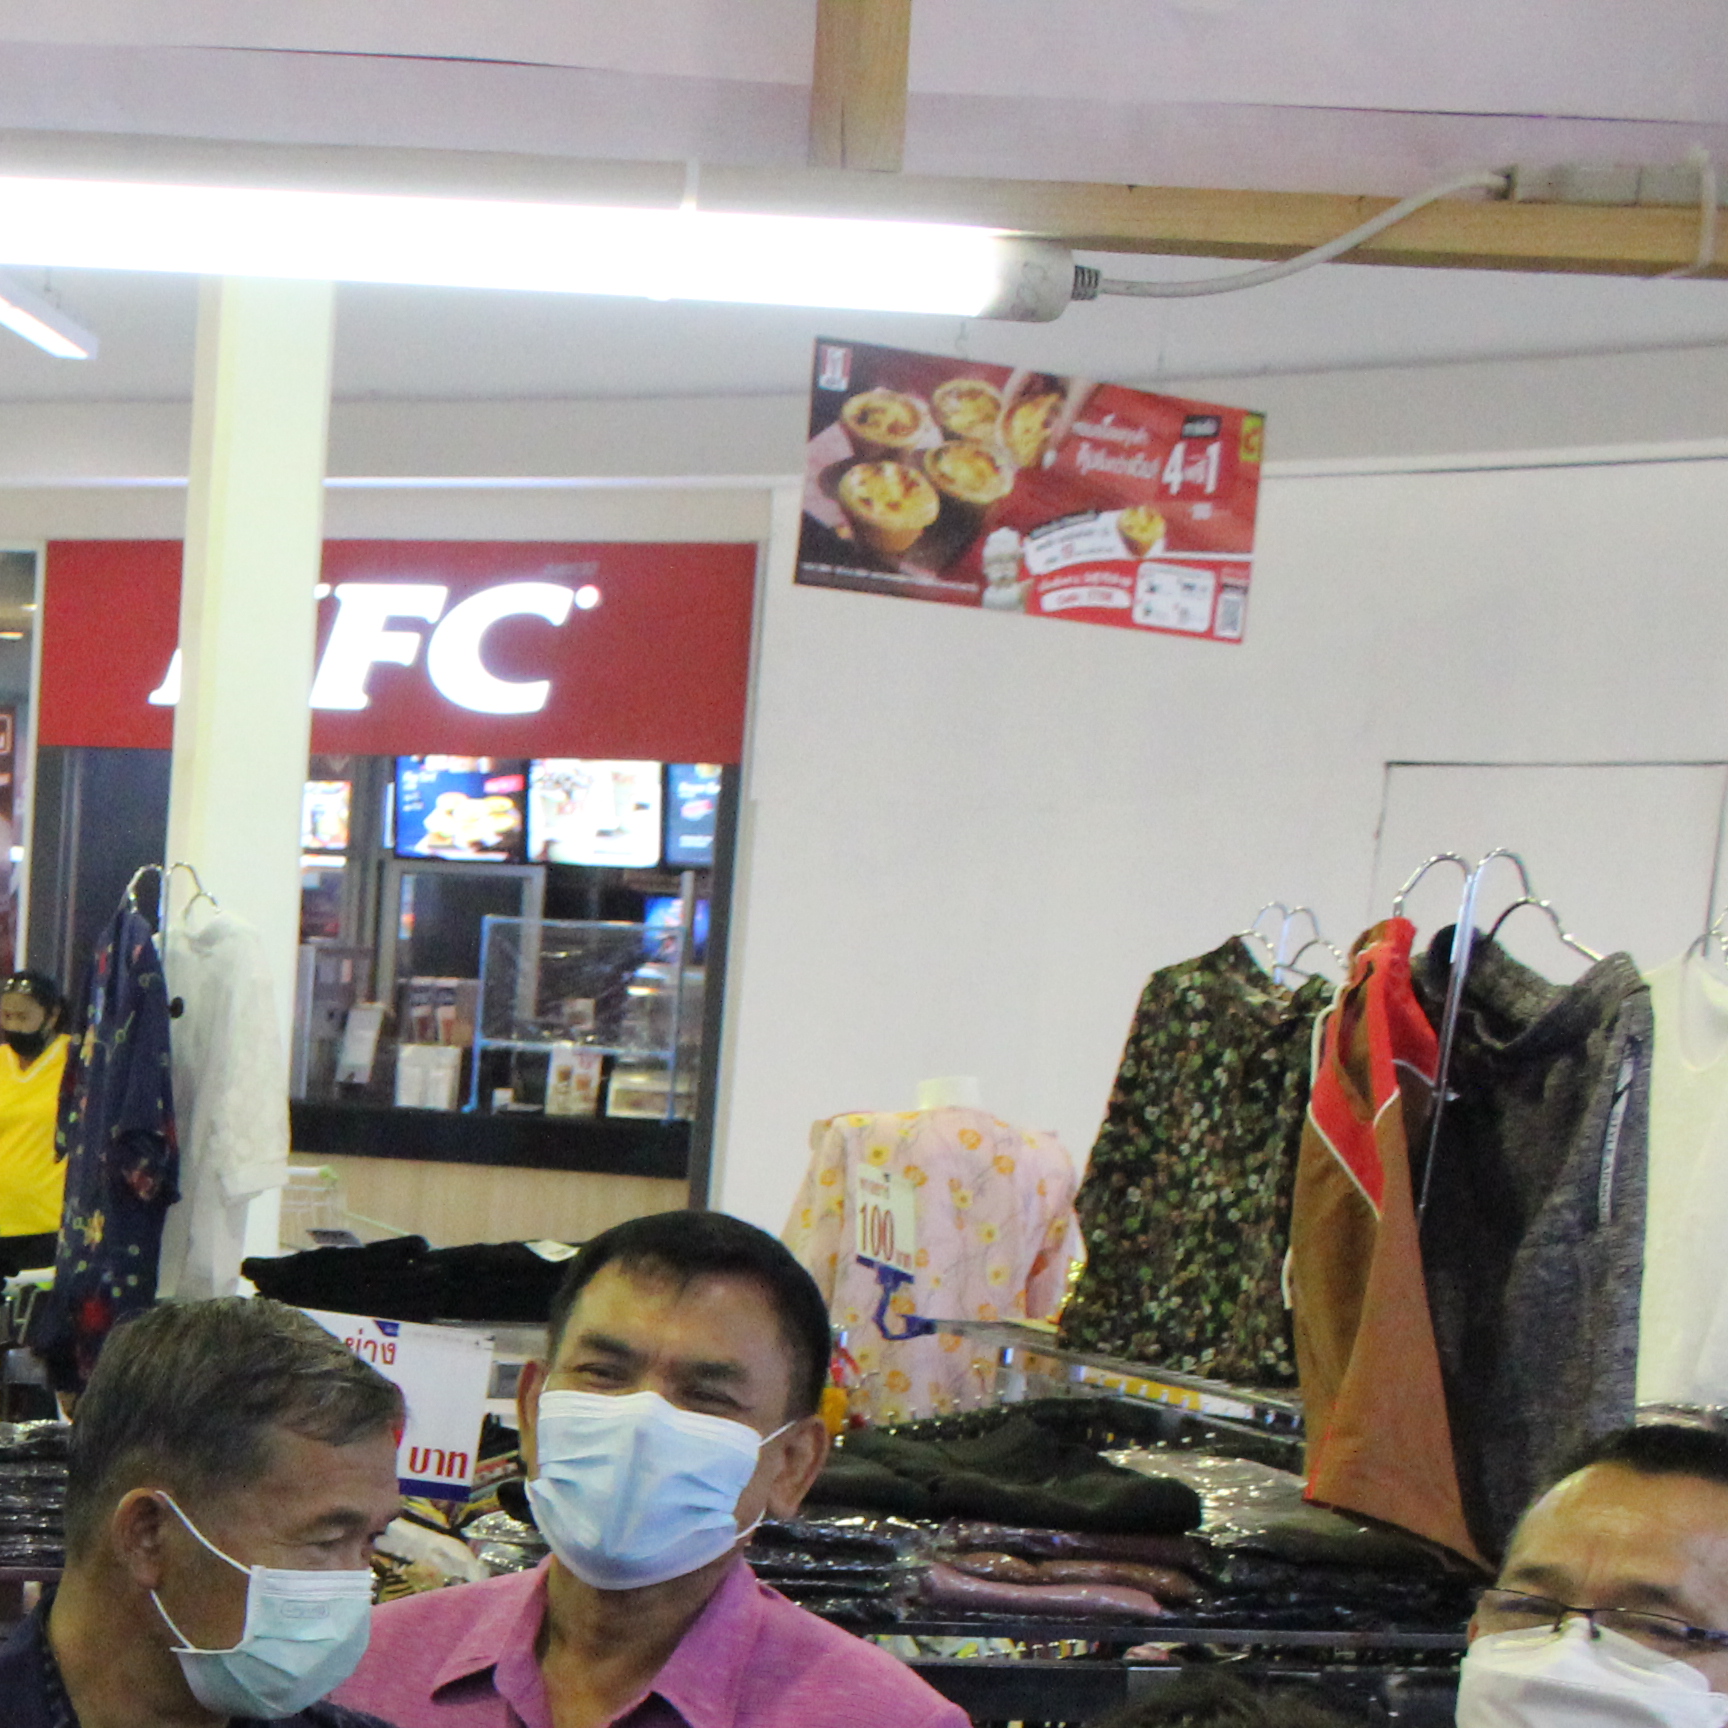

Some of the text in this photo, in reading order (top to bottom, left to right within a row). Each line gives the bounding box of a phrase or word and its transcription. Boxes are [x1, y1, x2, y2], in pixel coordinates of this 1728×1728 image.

[148, 581, 575, 715] FC
[860, 1202, 895, 1261] 100
[408, 1446, 469, 1479] บาท
